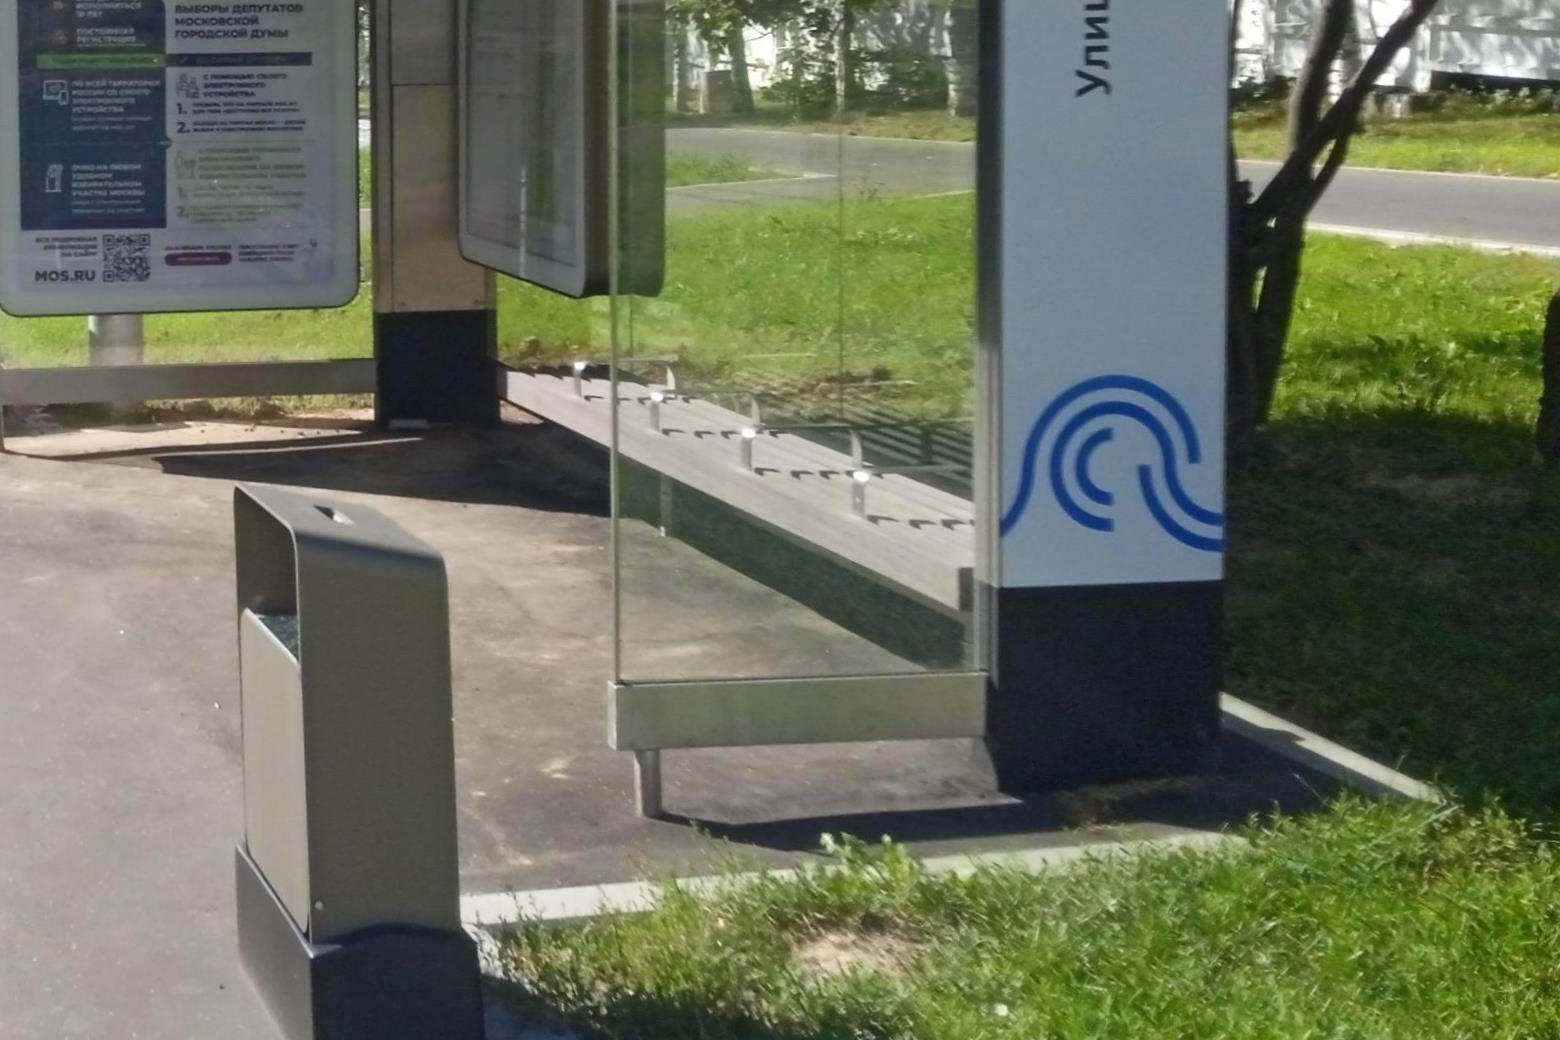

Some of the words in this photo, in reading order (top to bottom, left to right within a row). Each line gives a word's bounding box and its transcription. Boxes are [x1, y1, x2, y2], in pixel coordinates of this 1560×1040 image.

[174, 4, 229, 14] ВЫБОРЫ
[232, 3, 305, 15] ДЕПУТАТОВ
[174, 15, 260, 26] МОСКОВСКОЙ
[174, 27, 248, 39] ГОРОДСКОЙ
[250, 28, 289, 39] ДУМЫ
[34, 270, 97, 283] MOS.RU
